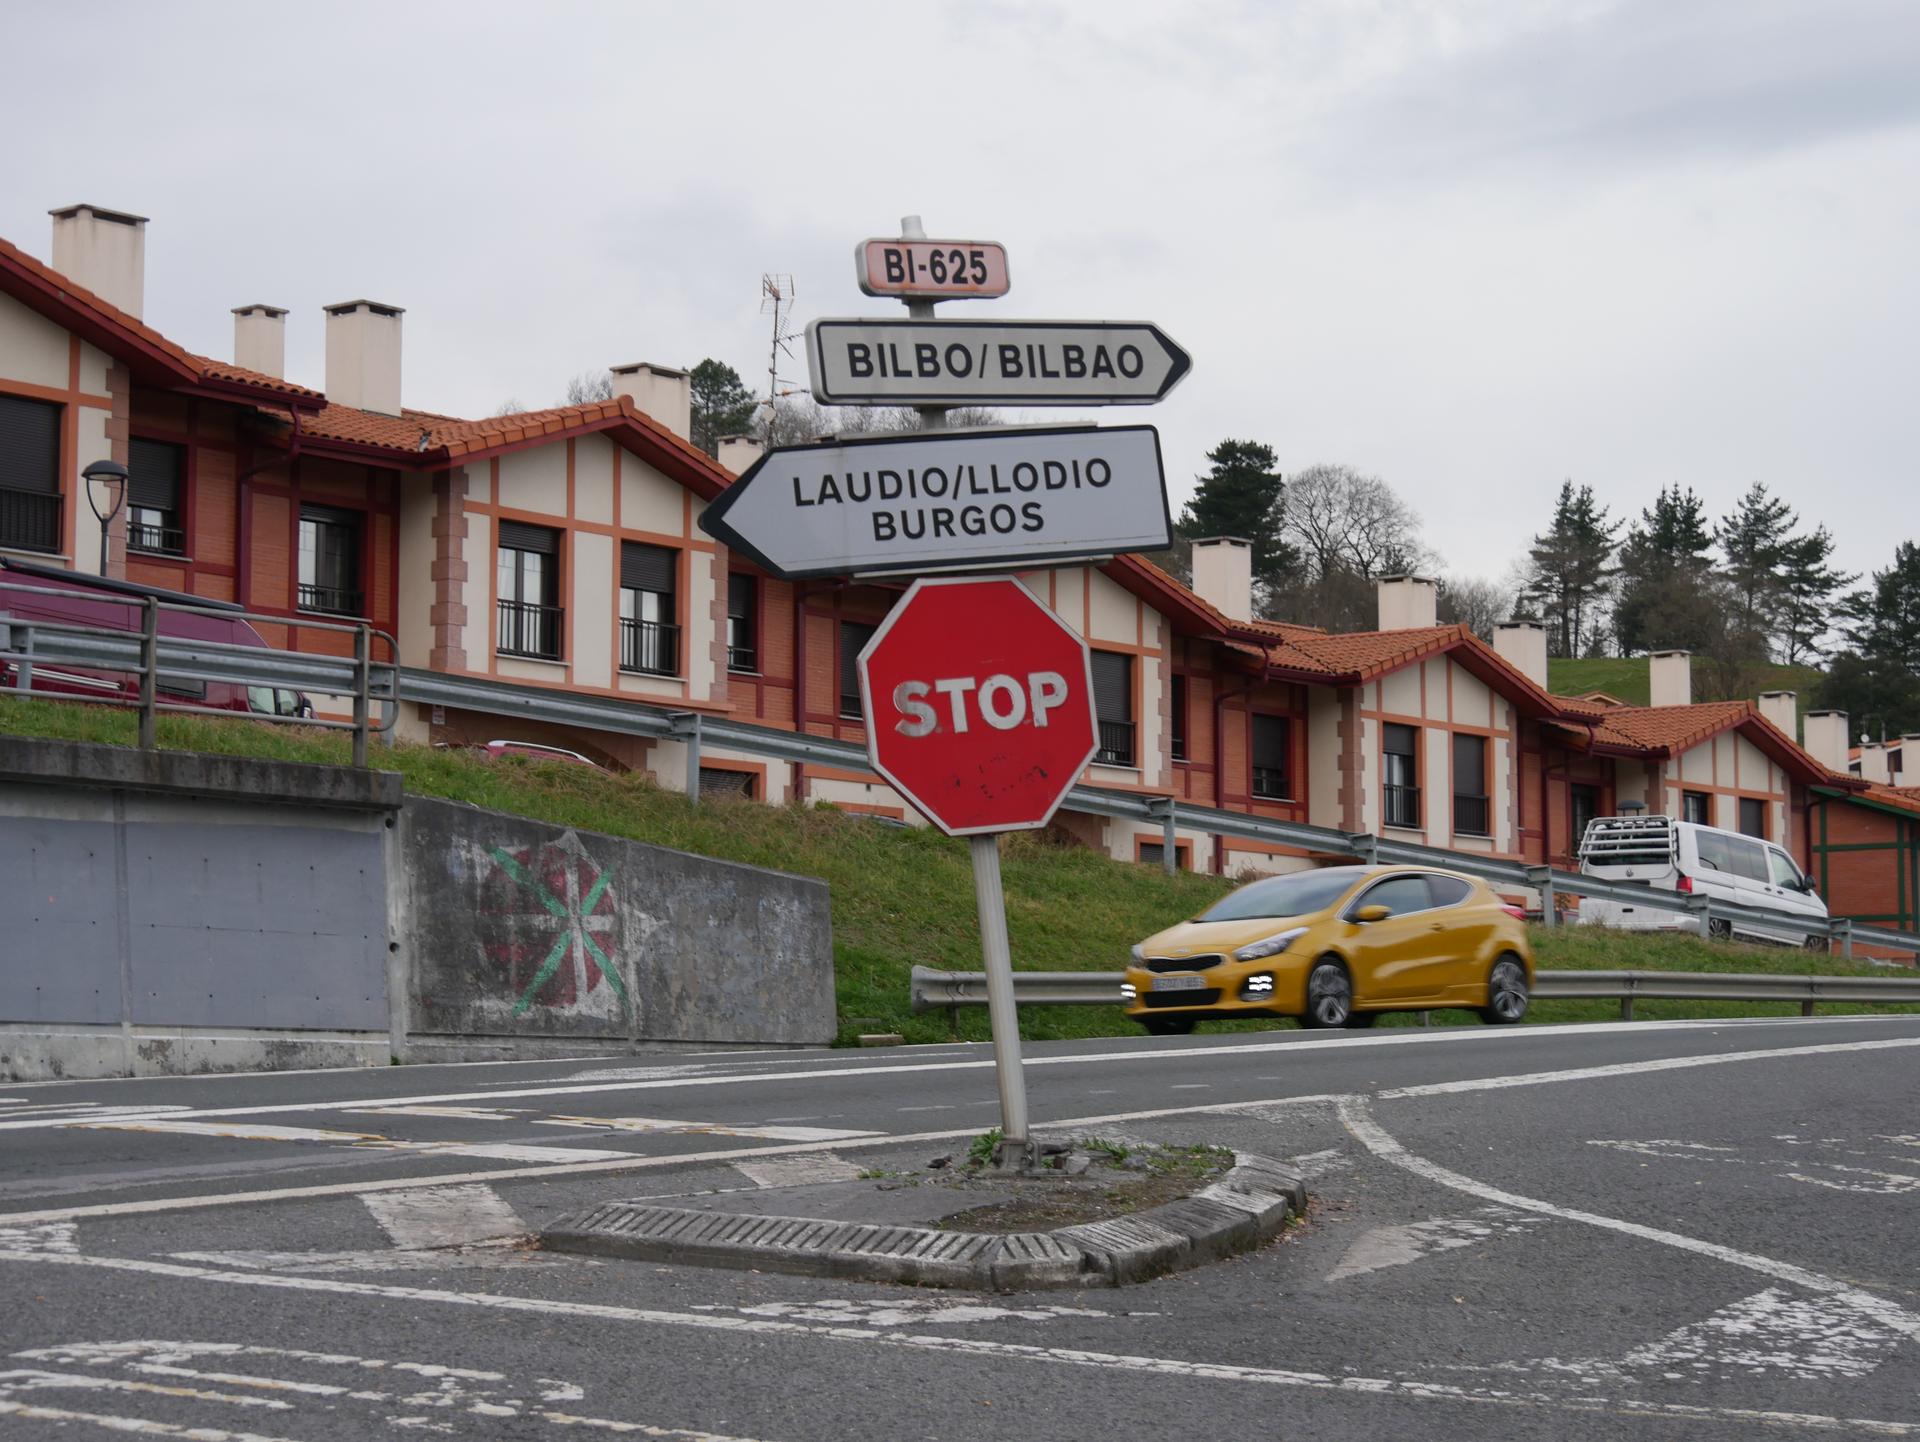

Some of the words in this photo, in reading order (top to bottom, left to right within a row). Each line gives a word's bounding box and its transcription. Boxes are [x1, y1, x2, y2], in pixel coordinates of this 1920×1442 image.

[884, 248, 988, 285] BI-625
[846, 342, 1144, 379] BILBO/BILBAO
[792, 457, 1112, 507] LAUDIO/LLODIO
[871, 501, 1045, 542] BURGOS
[892, 670, 1069, 738] STOP
